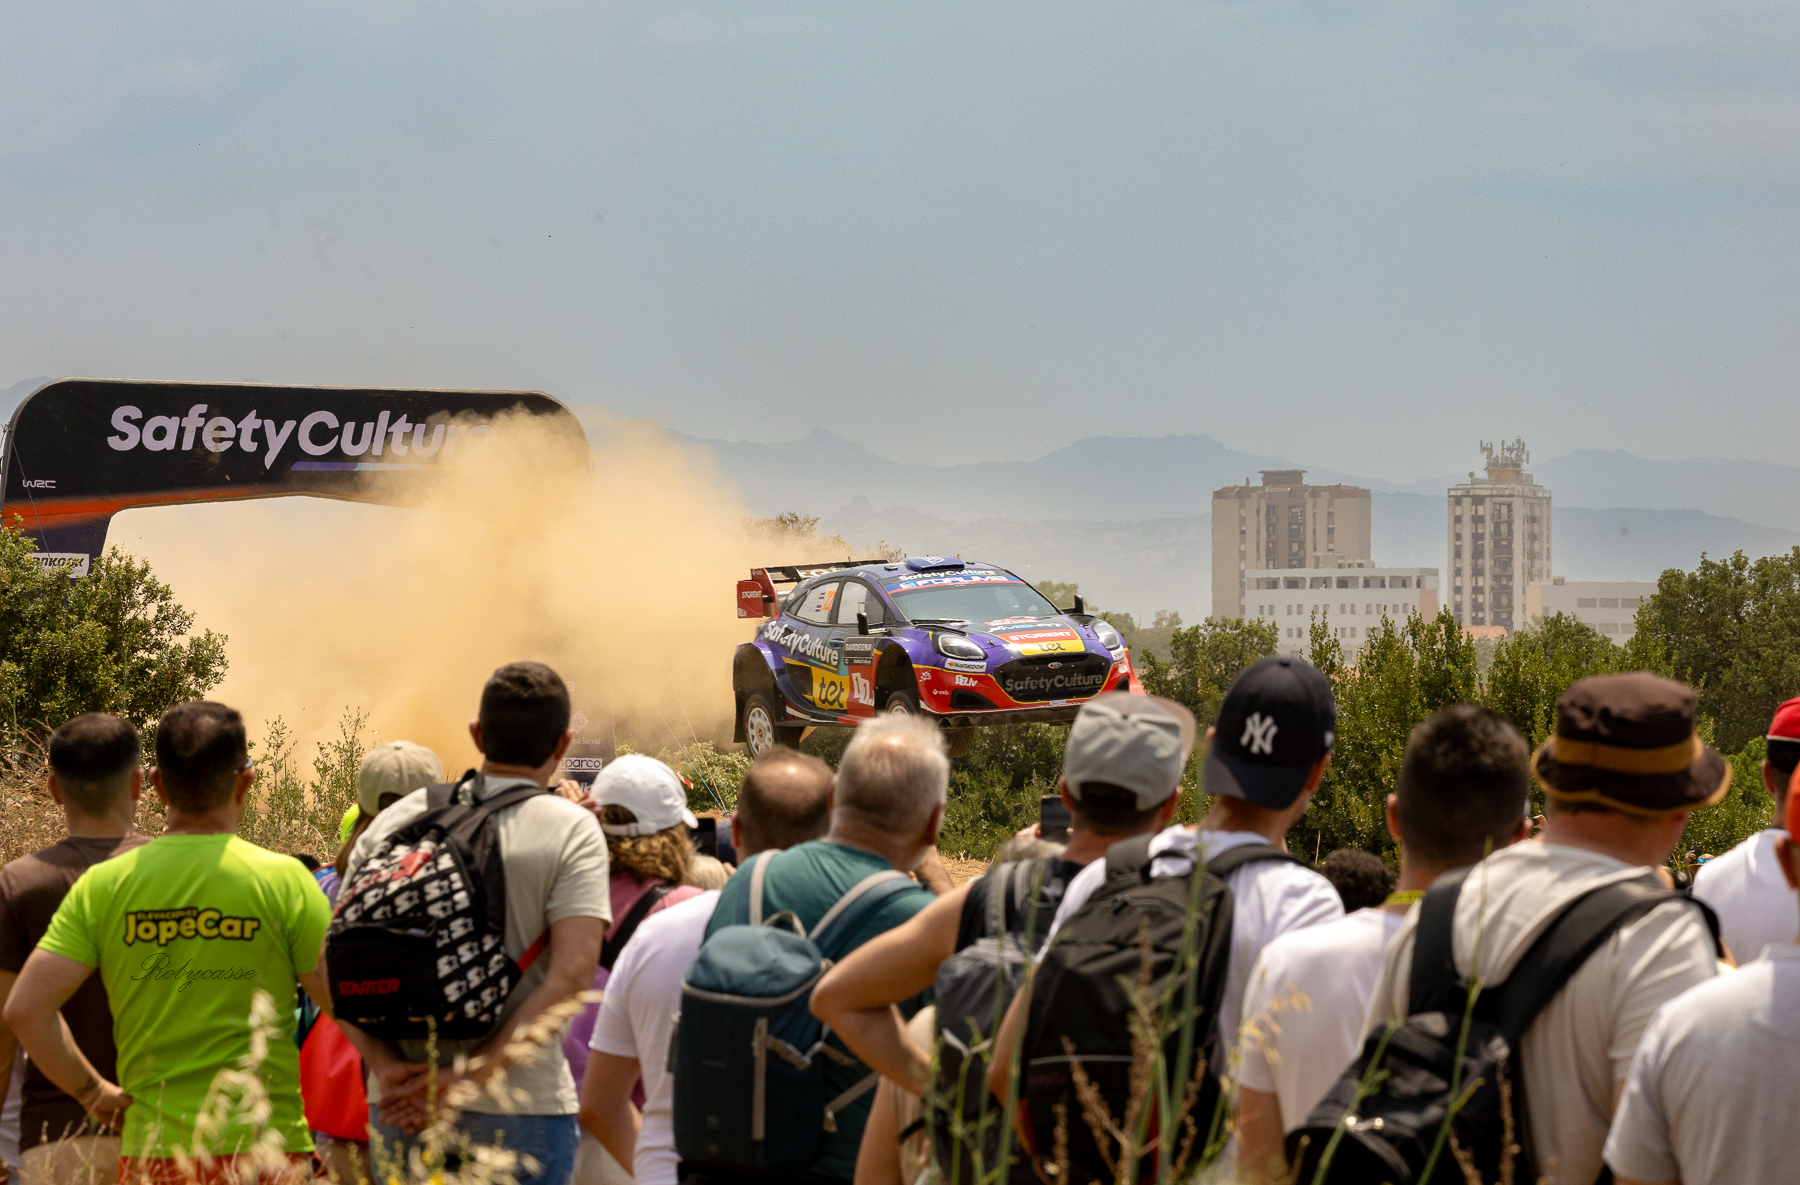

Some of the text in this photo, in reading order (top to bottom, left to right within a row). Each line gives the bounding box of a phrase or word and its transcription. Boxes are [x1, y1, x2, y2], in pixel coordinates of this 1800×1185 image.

[107, 403, 497, 469] SafetyCulture
[22, 479, 57, 489] WRC
[33, 557, 85, 567] ankook
[898, 569, 996, 581] SafetyCulture
[822, 590, 837, 611] 22
[764, 620, 840, 666] SafetyCulture
[1008, 631, 1072, 641] STORENT
[1039, 642, 1066, 652] tet
[819, 677, 845, 709] tet
[1005, 673, 1104, 693] SafetyCulture
[1240, 711, 1279, 755] NY
[123, 909, 261, 946] JopeCar
[338, 978, 400, 996] STARTER
